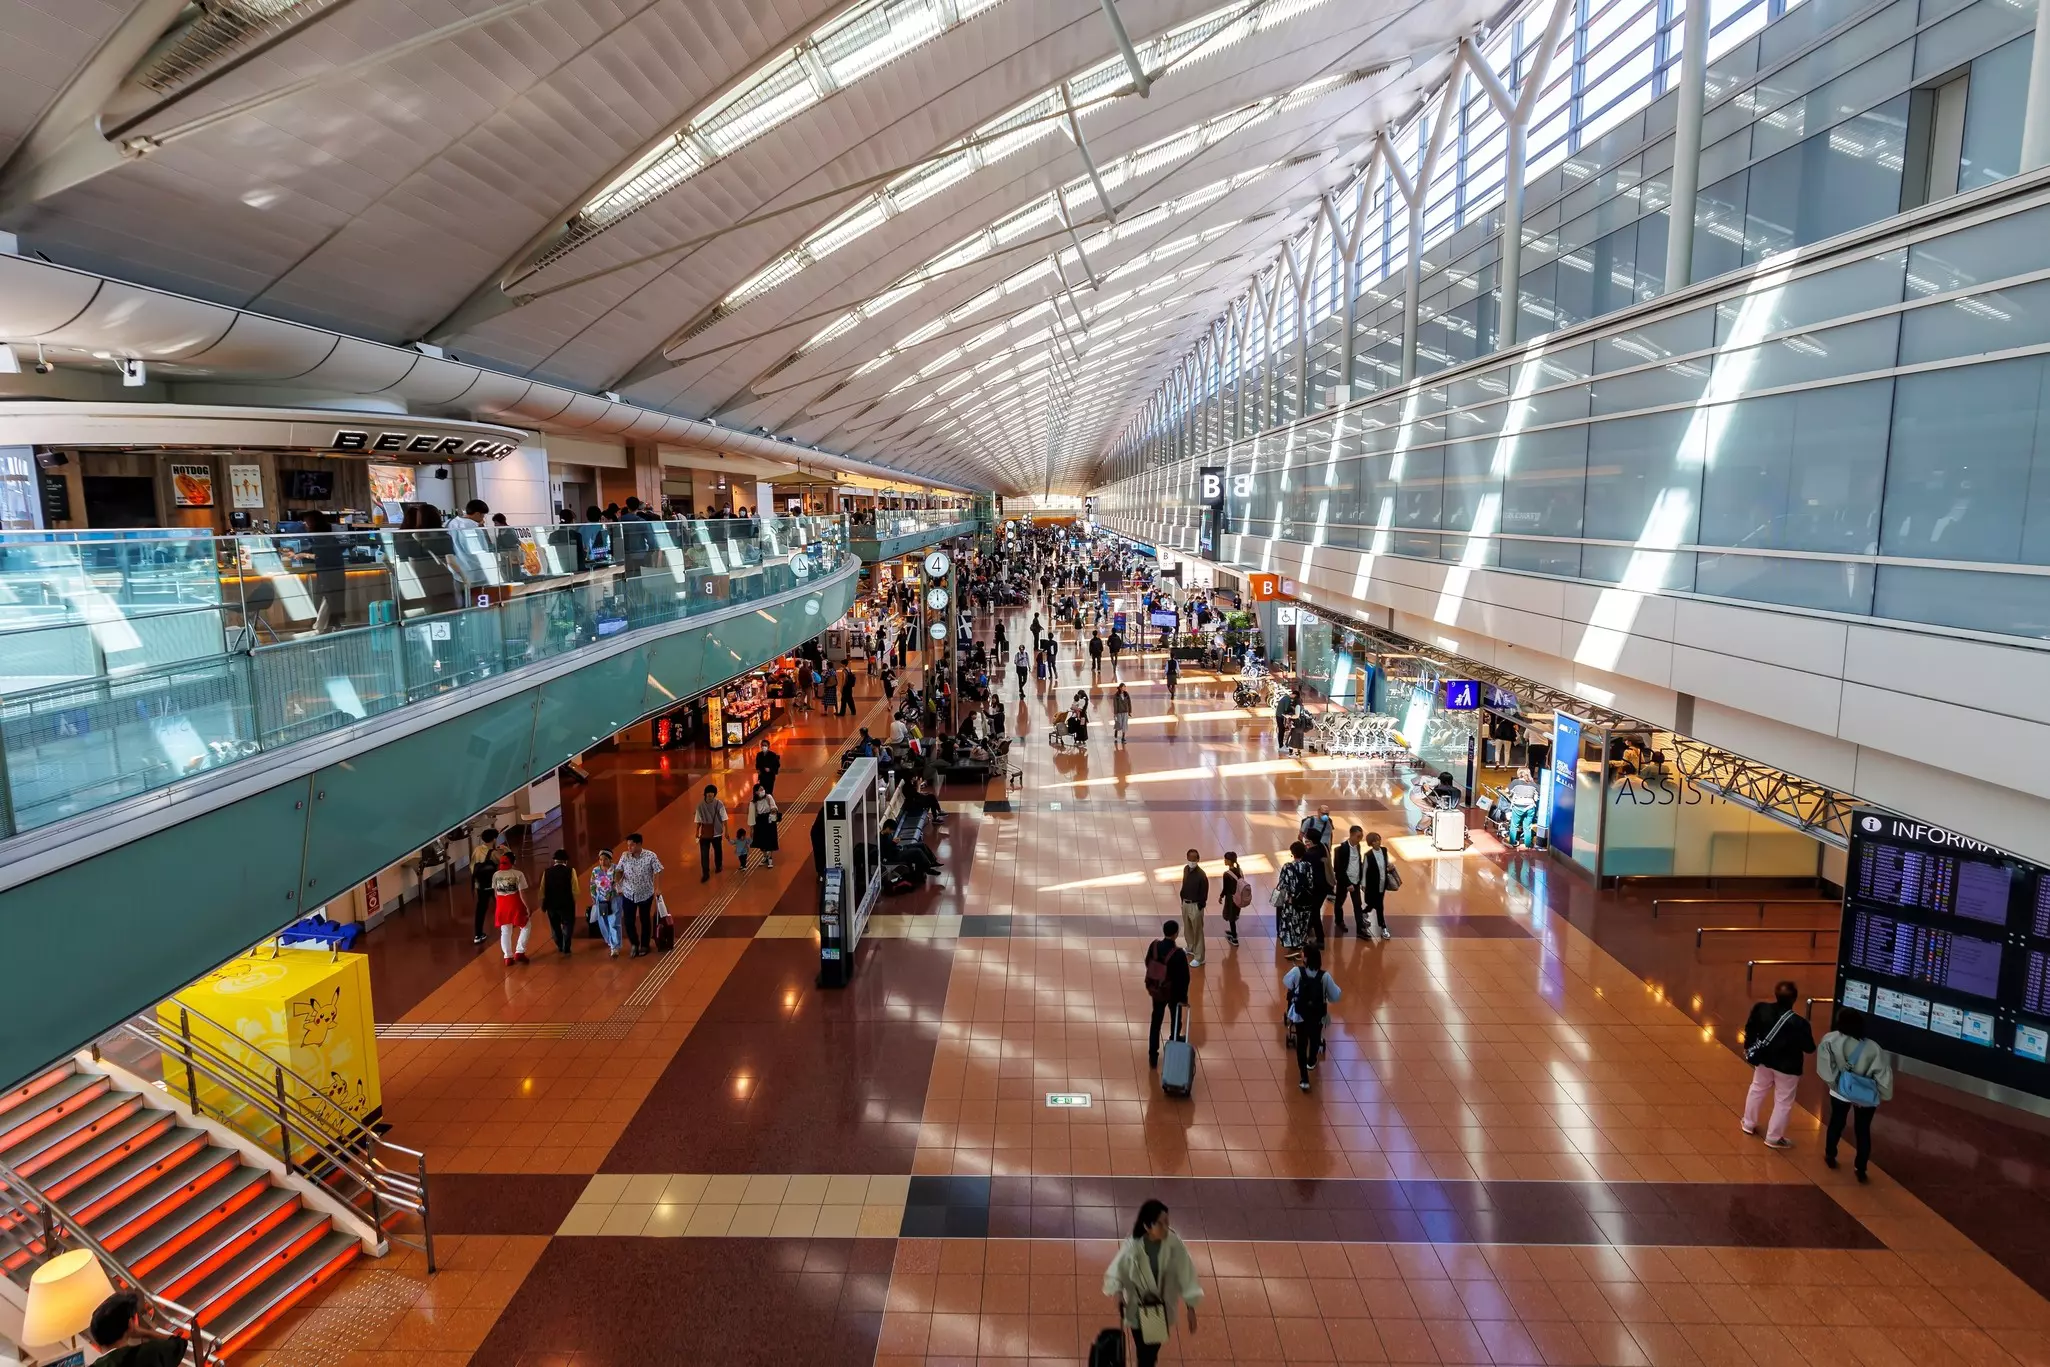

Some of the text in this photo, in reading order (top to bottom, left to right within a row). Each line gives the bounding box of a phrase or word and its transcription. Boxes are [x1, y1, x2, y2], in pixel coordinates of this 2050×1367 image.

[332, 429, 464, 455] BEER
[173, 465, 209, 476] HOTDOG
[1203, 474, 1221, 498] B
[514, 527, 532, 539] TDOG
[1163, 552, 1169, 560] B
[931, 556, 942, 572] 4
[1263, 581, 1273, 595] B
[833, 826, 842, 869] Informati
